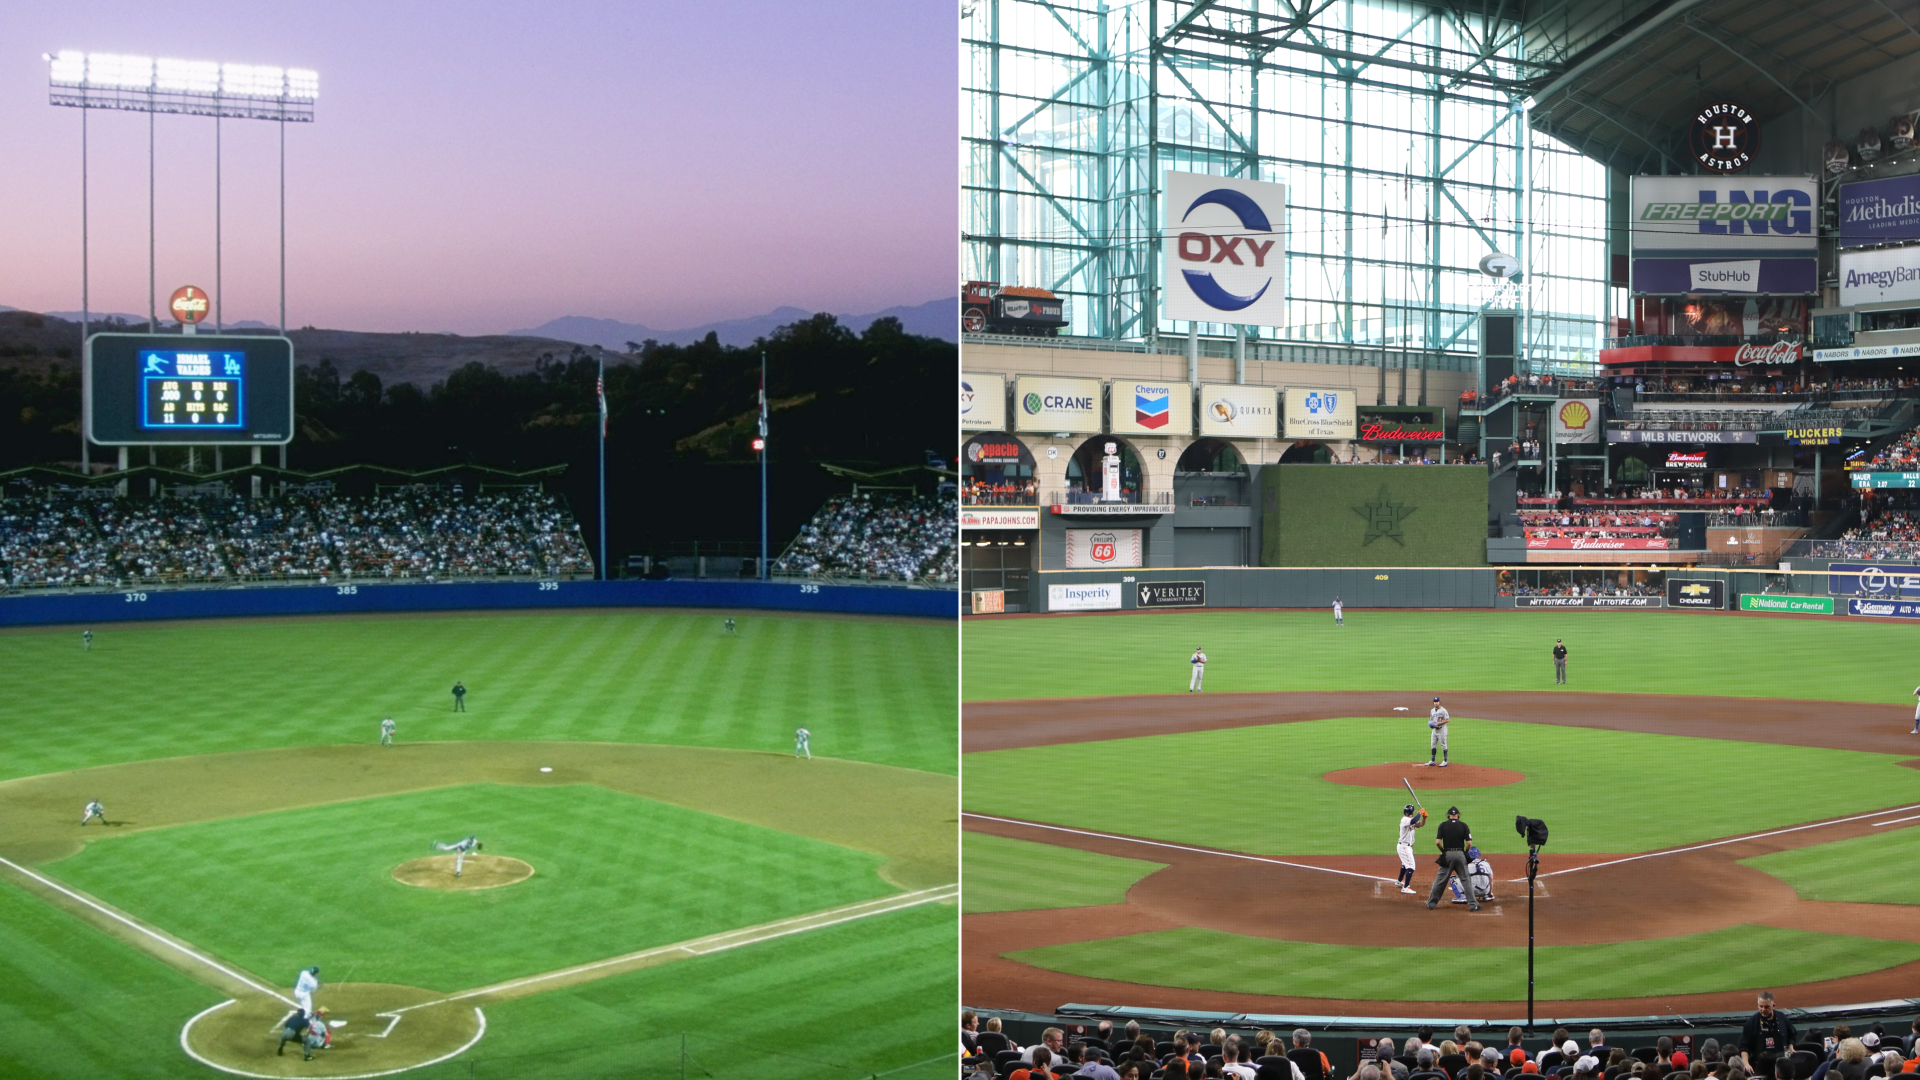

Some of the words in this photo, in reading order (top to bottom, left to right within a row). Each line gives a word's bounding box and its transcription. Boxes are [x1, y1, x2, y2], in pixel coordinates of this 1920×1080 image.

[1698, 104, 1752, 124] HOUSTON
[1712, 126, 1738, 149] H
[1700, 152, 1749, 170] ASTROS
[1846, 196, 1880, 205] HOUSTON
[1646, 203, 1787, 220] FREEPORT
[1698, 189, 1812, 234] LNG
[1868, 220, 1896, 230] LEADING
[1178, 232, 1276, 268] OXY
[1698, 270, 1750, 282] StubHub
[1734, 340, 1802, 366] Coca-Cola
[1824, 351, 1849, 359] NABORS
[1862, 348, 1887, 357] NABORS
[176, 354, 210, 364] ISMAEL
[176, 365, 211, 375] VALDES
[1136, 385, 1169, 394] Chevron
[194, 391, 202, 400] 0
[216, 391, 224, 400] 0
[1044, 396, 1093, 410] CRANE
[1240, 406, 1272, 415] QUANTA
[164, 414, 174, 423] 11
[192, 414, 199, 423] 0
[217, 414, 224, 423] 0
[1360, 424, 1444, 440] Budweiser
[1642, 432, 1664, 442] MLB
[1668, 433, 1721, 442] NETWORK
[1786, 428, 1842, 438] PLUCKERS
[982, 442, 1018, 458] apache
[1668, 454, 1704, 462] Budweiser
[982, 516, 1036, 524] PAPAJOHNS.COM
[1571, 538, 1625, 549] Budweiser
[1094, 546, 1112, 557] 66
[337, 586, 358, 595] 385
[539, 581, 558, 590] 395
[800, 584, 819, 594] 395
[126, 593, 147, 602] 370
[1065, 588, 1111, 600] Insperity
[1154, 588, 1200, 598] VERITEX
[1758, 599, 1788, 608] National
[1866, 602, 1895, 610] Germania
